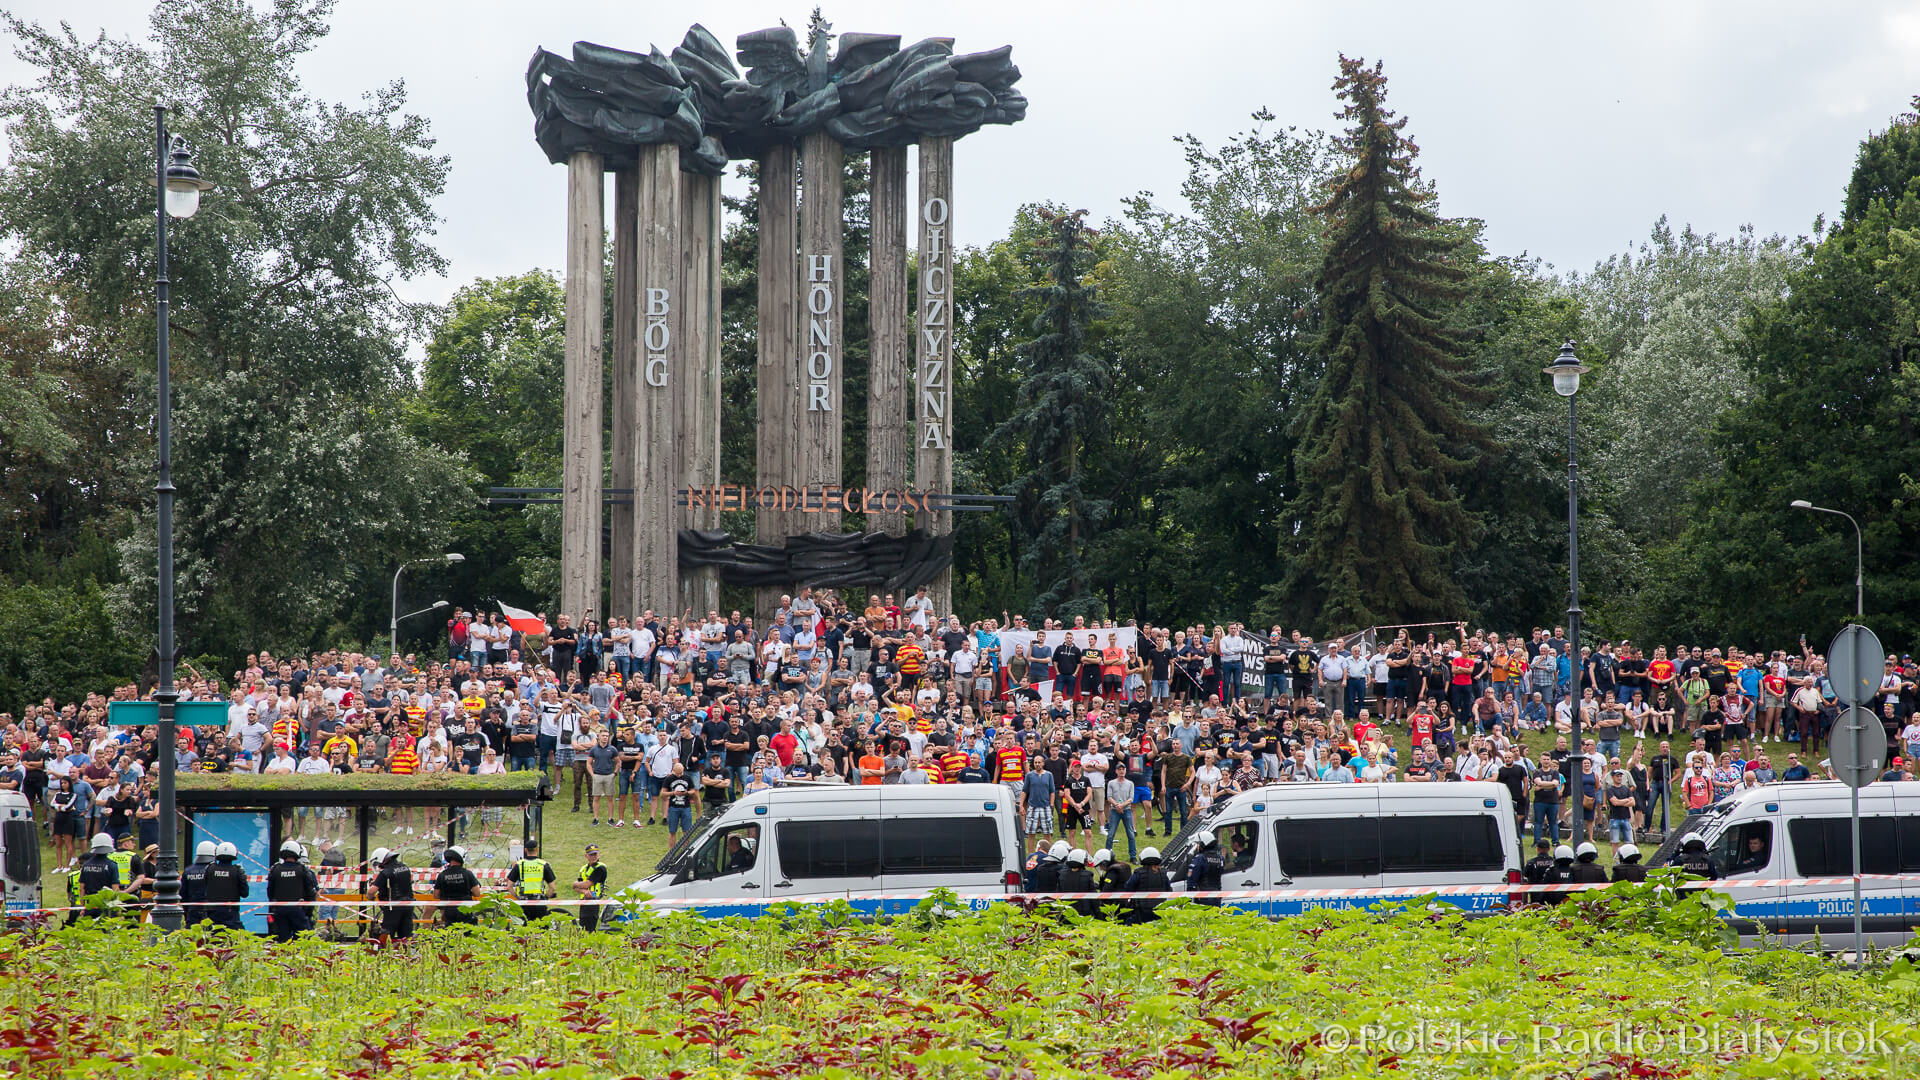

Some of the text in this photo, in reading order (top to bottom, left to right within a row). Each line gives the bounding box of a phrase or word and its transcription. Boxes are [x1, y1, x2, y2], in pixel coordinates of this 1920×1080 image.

[807, 254, 833, 412] HONOR
[920, 197, 949, 450] OJCZYZNA
[1471, 896, 1503, 909] Z 775
[1818, 901, 1871, 914] POLICA
